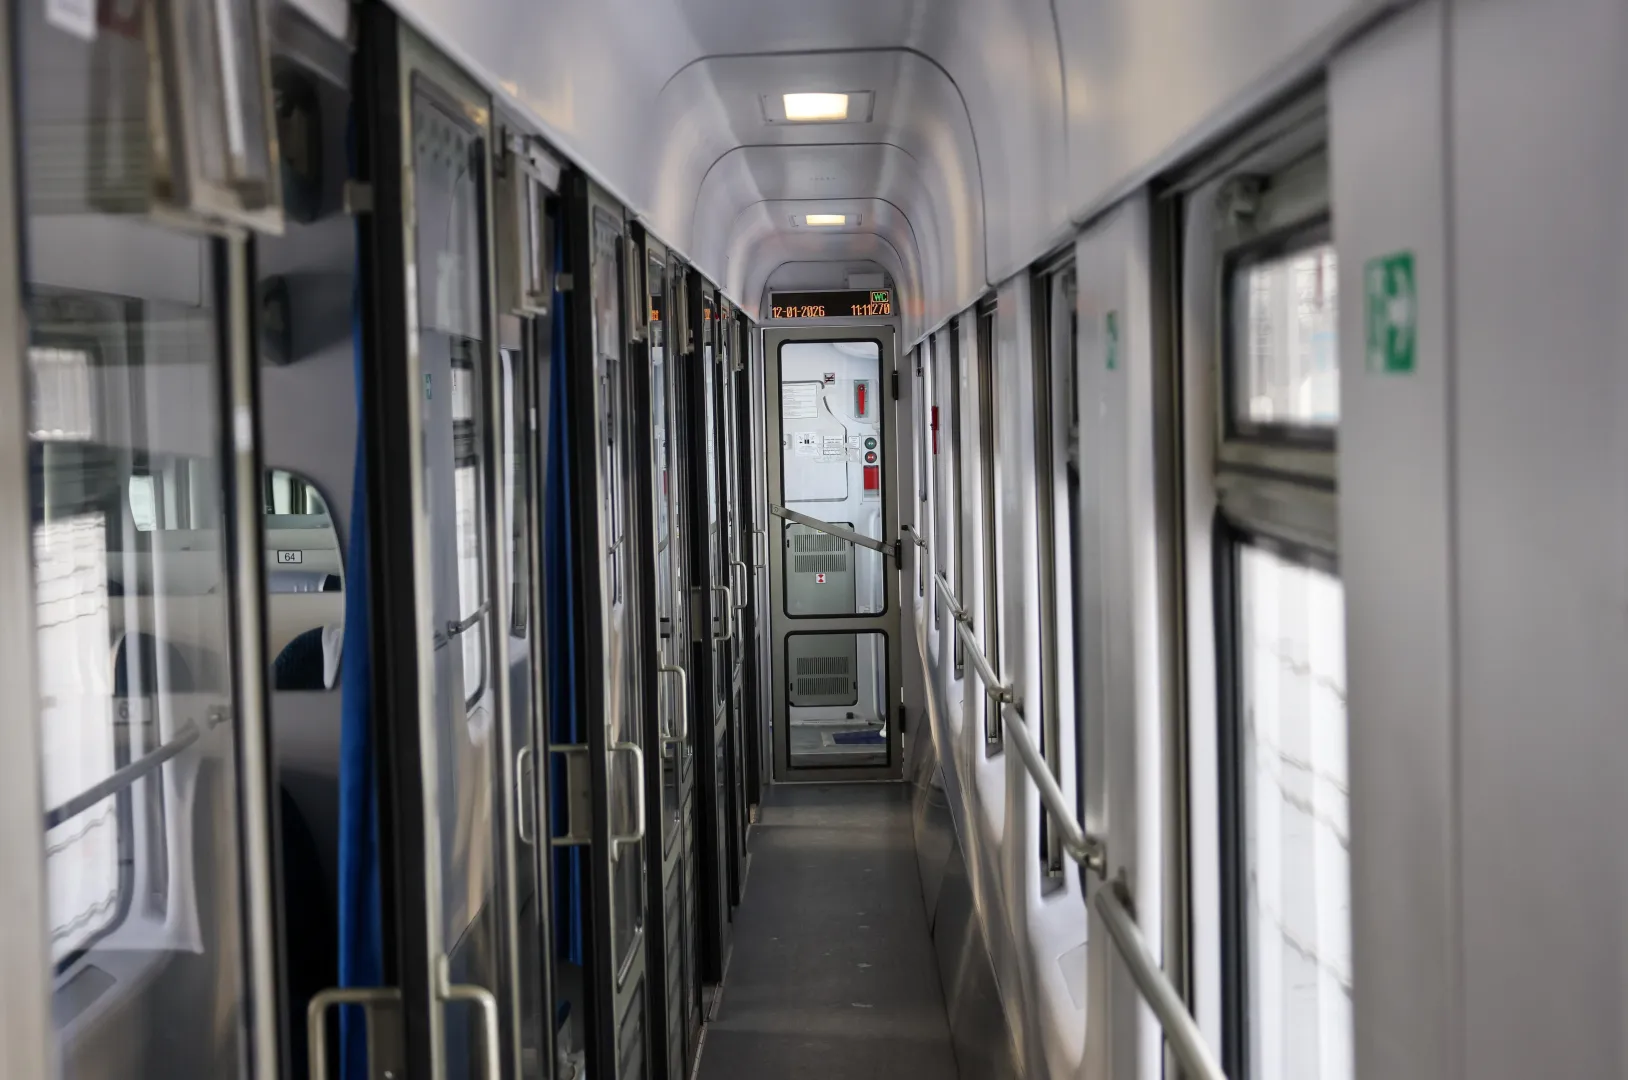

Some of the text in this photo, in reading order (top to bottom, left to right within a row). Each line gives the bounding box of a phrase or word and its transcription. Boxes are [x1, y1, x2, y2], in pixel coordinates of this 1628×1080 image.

[874, 292, 886, 301] WC
[772, 304, 870, 318] 12-01-2026 11:11
[872, 303, 890, 315] 270
[285, 552, 295, 561] 64
